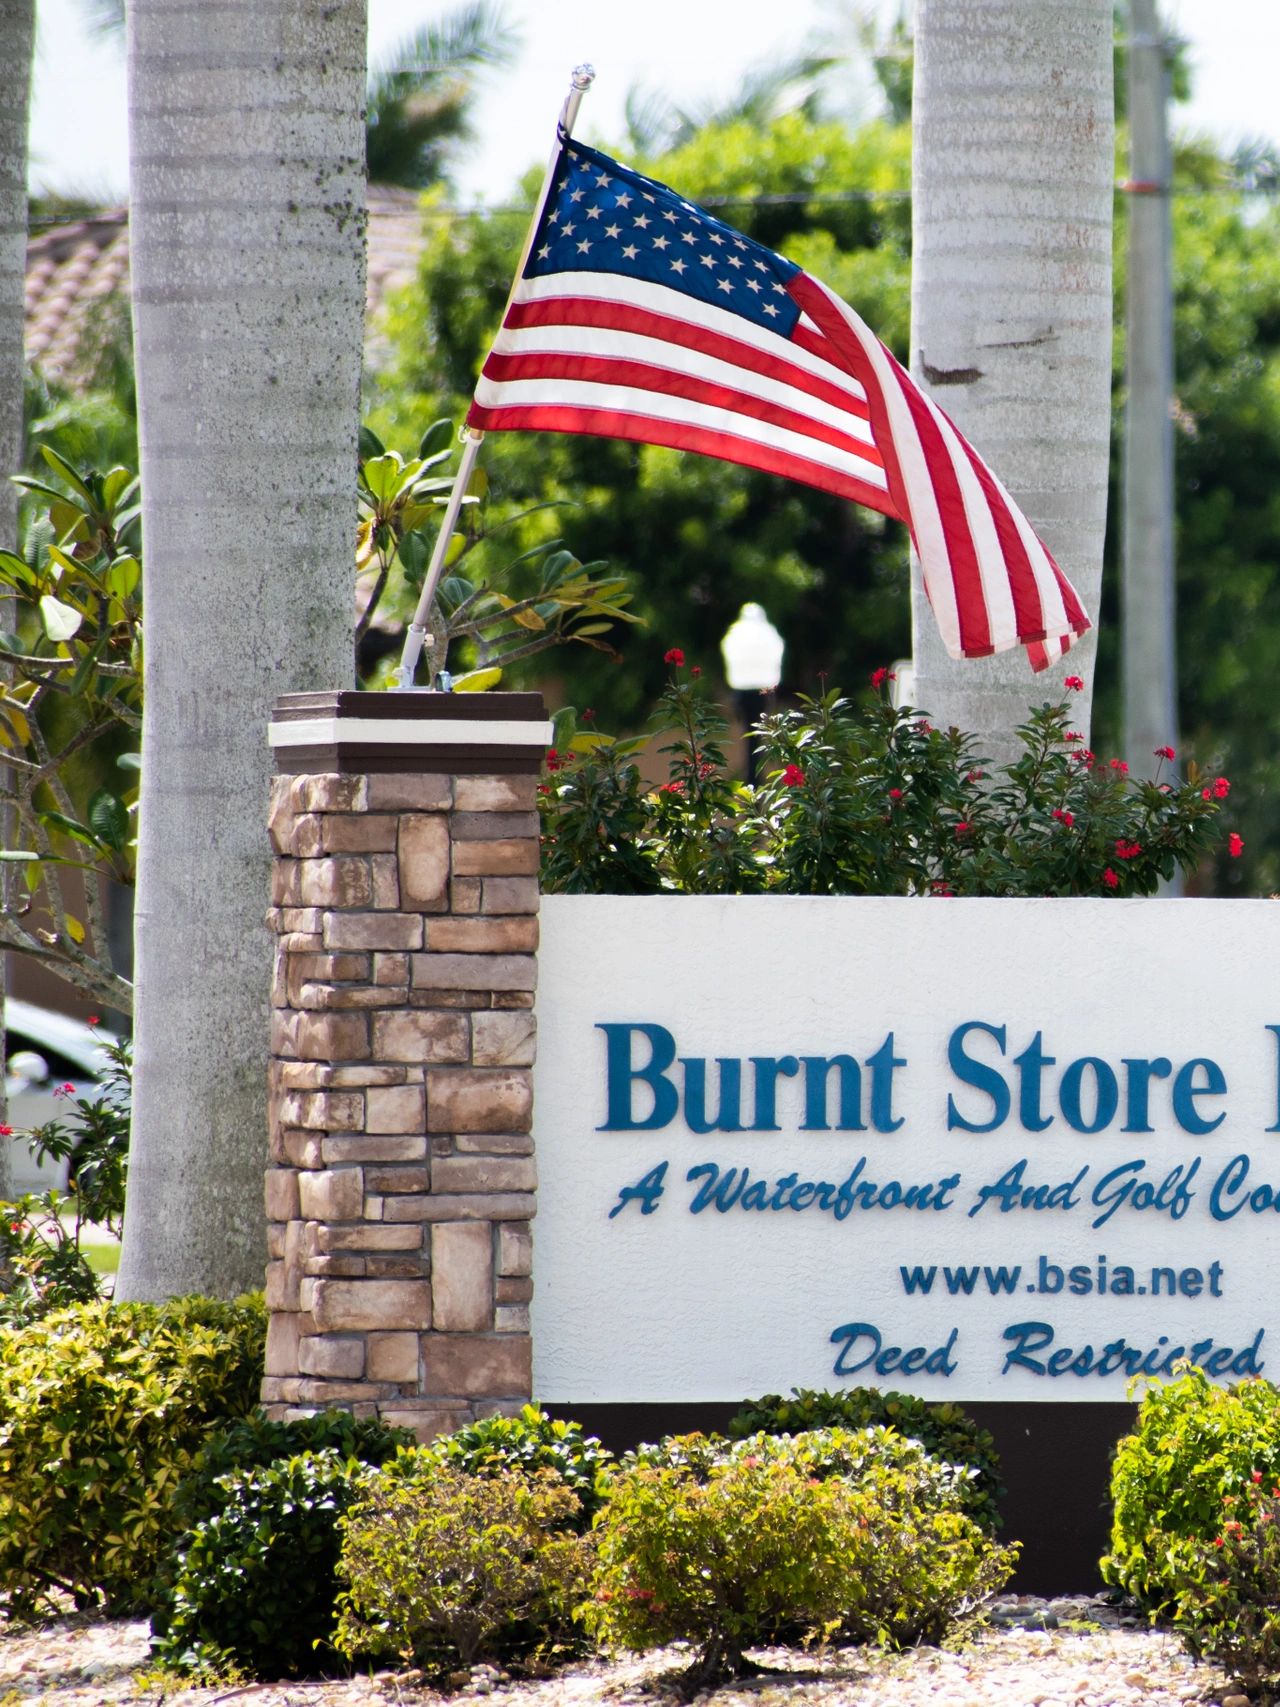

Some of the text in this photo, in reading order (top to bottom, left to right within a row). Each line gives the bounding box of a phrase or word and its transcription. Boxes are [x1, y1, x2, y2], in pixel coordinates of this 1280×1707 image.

[594, 1023, 907, 1134] Burnt
[946, 1021, 1227, 1135] Store
[607, 1161, 670, 1220] A
[686, 1157, 961, 1222] Waterfront
[967, 1159, 1090, 1218] And
[1092, 1156, 1202, 1229] Golf
[900, 1256, 1224, 1297] www.bsia.net
[829, 1321, 1266, 1378] Deed Restricted
